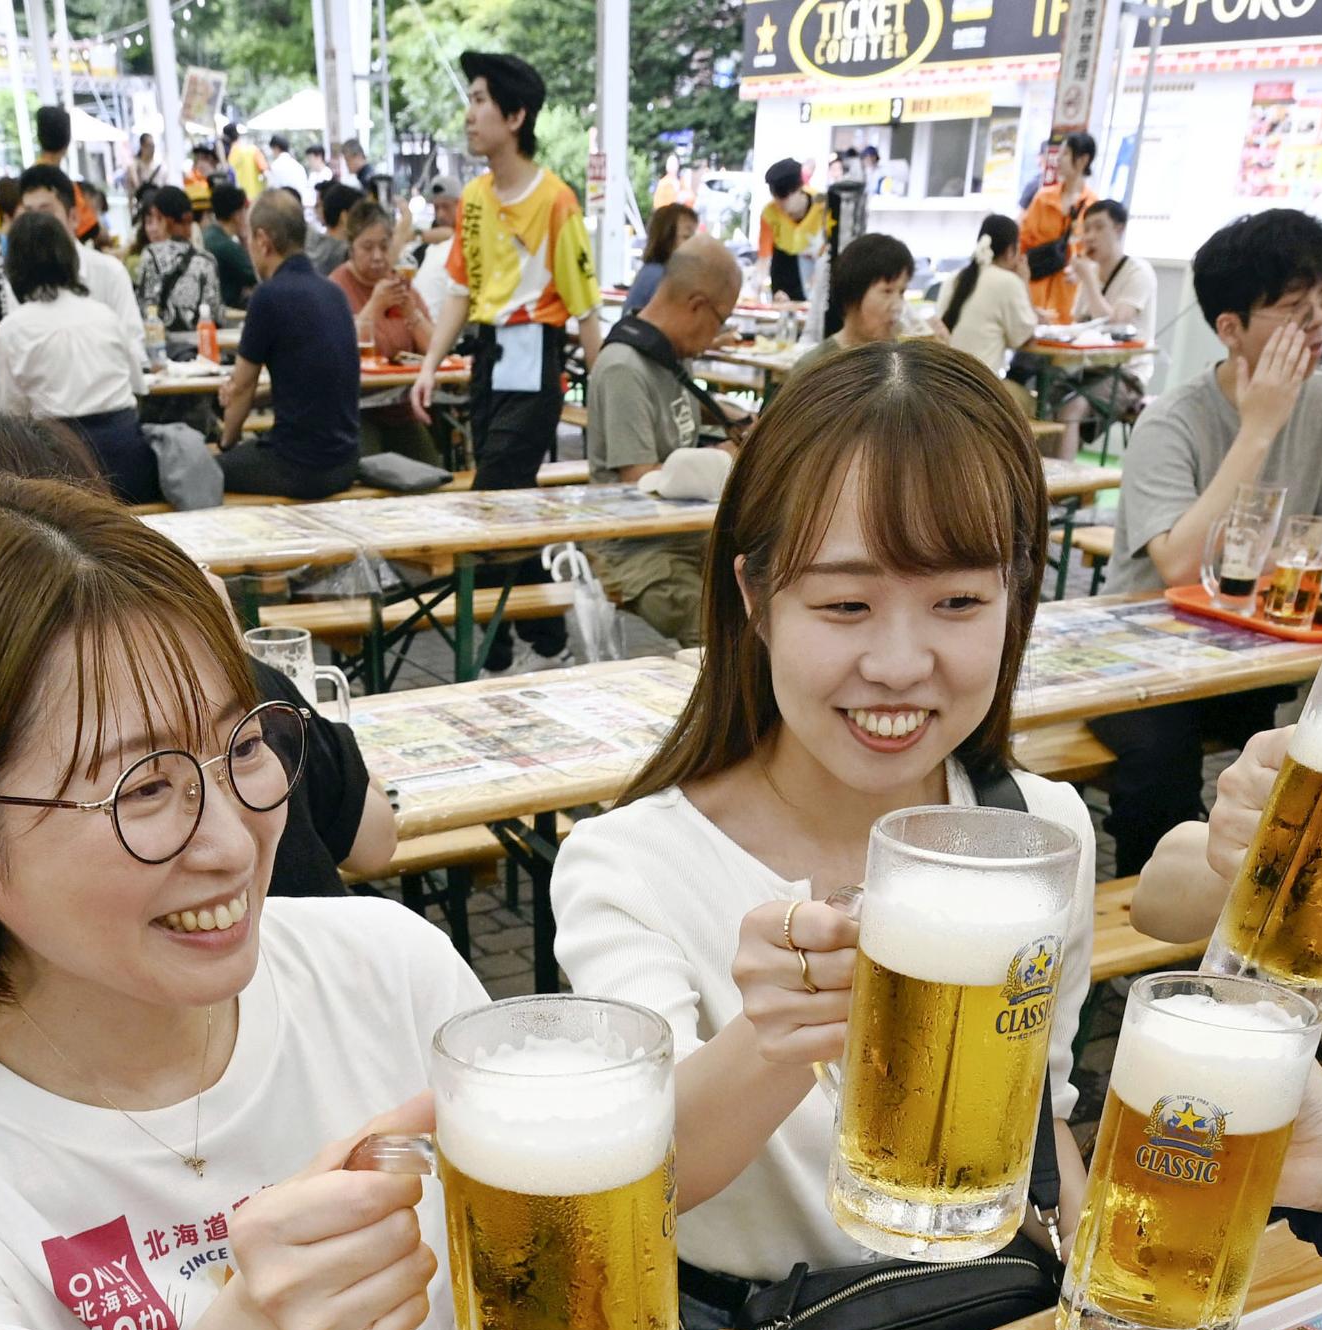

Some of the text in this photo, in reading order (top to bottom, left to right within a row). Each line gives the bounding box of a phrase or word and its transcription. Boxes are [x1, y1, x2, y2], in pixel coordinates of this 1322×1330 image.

[817, 0, 910, 41] TICKET
[815, 32, 909, 65] COUNTER
[1135, 1144, 1221, 1185] CLASSIC
[143, 1212, 229, 1261] 北海道
[179, 1247, 229, 1280] SINCE
